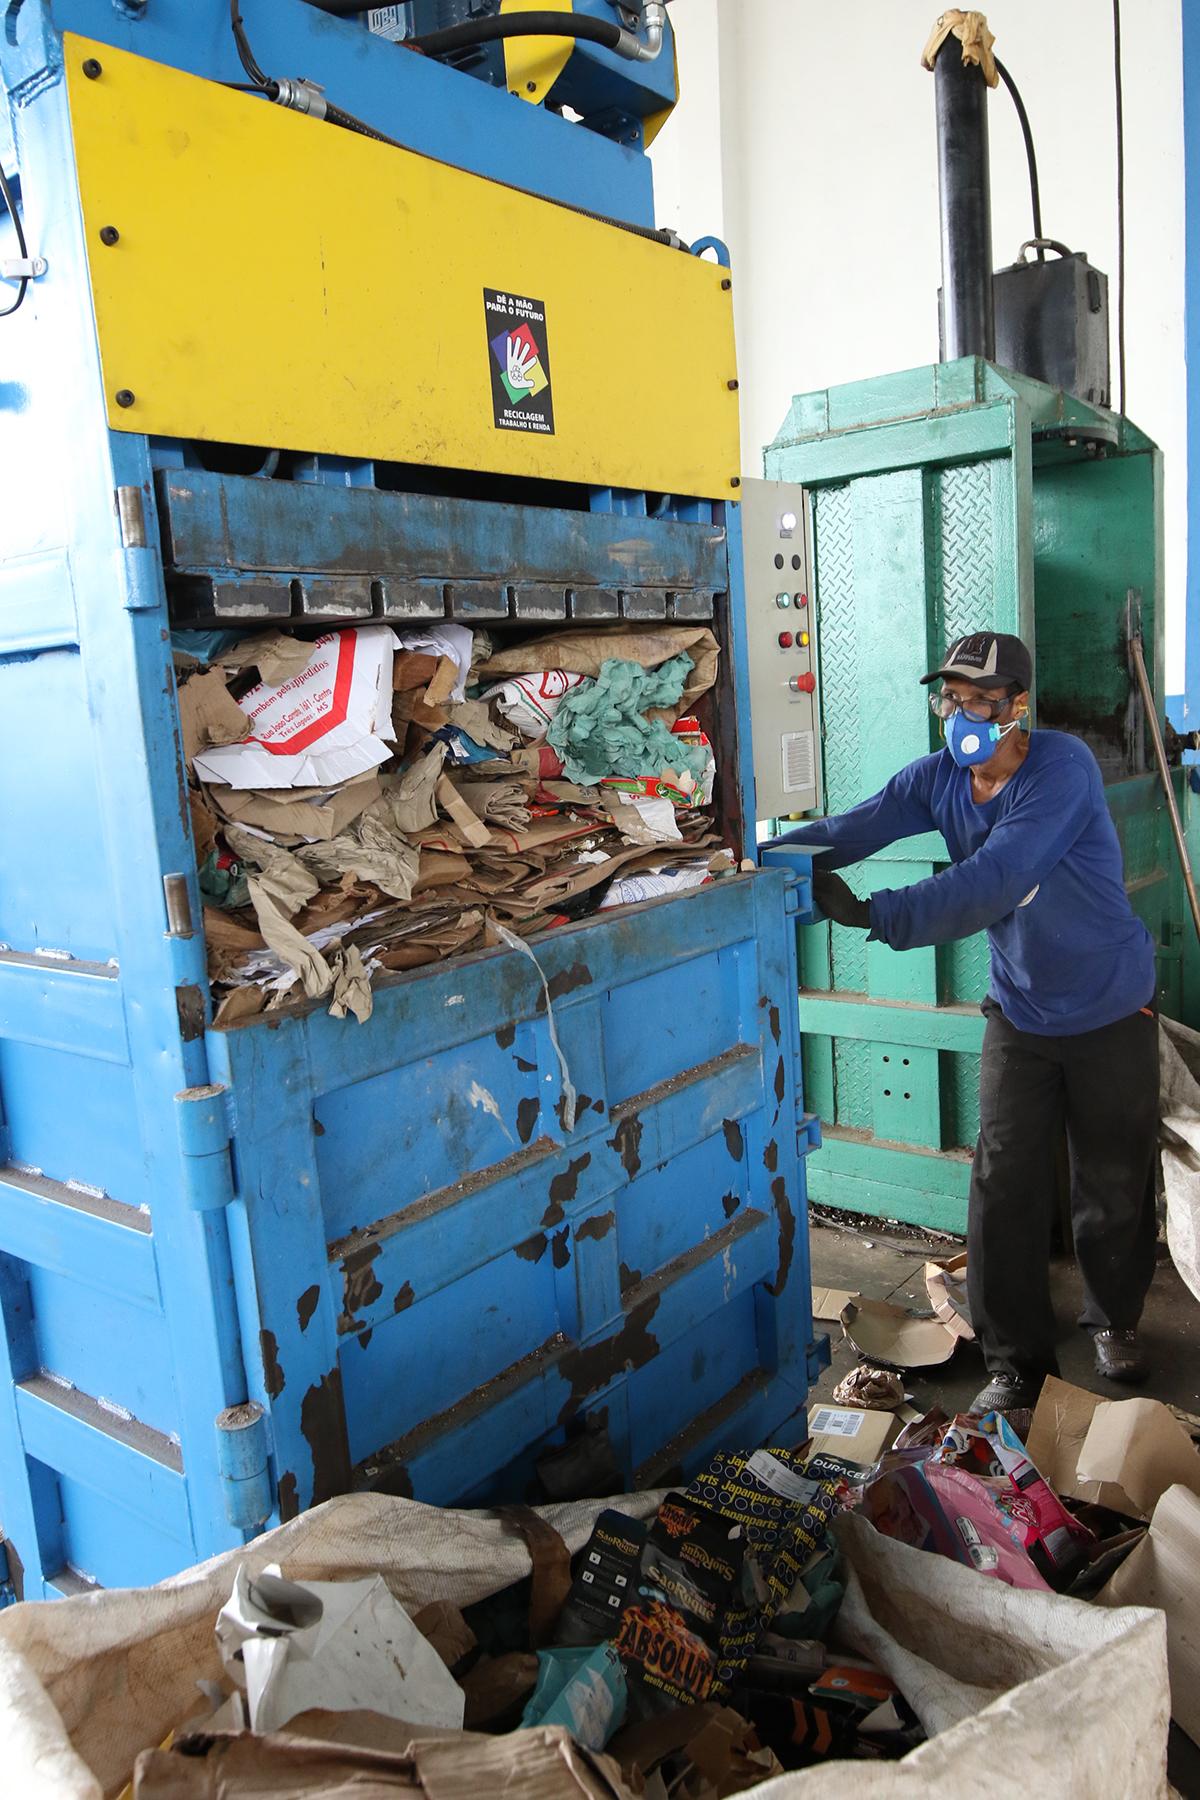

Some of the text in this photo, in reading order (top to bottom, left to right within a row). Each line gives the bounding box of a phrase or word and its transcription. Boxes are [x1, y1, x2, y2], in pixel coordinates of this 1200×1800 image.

[496, 295, 533, 310] DÊ A MÃO
[486, 302, 544, 321] PARA O FUTURO
[504, 409, 544, 422] RECICLAGEM
[498, 418, 528, 429] TRABALHO
[532, 422, 550, 432] RENDA
[313, 688, 332, 702] Centro
[316, 702, 329, 714] MS
[721, 1480, 784, 1507] Japanparts
